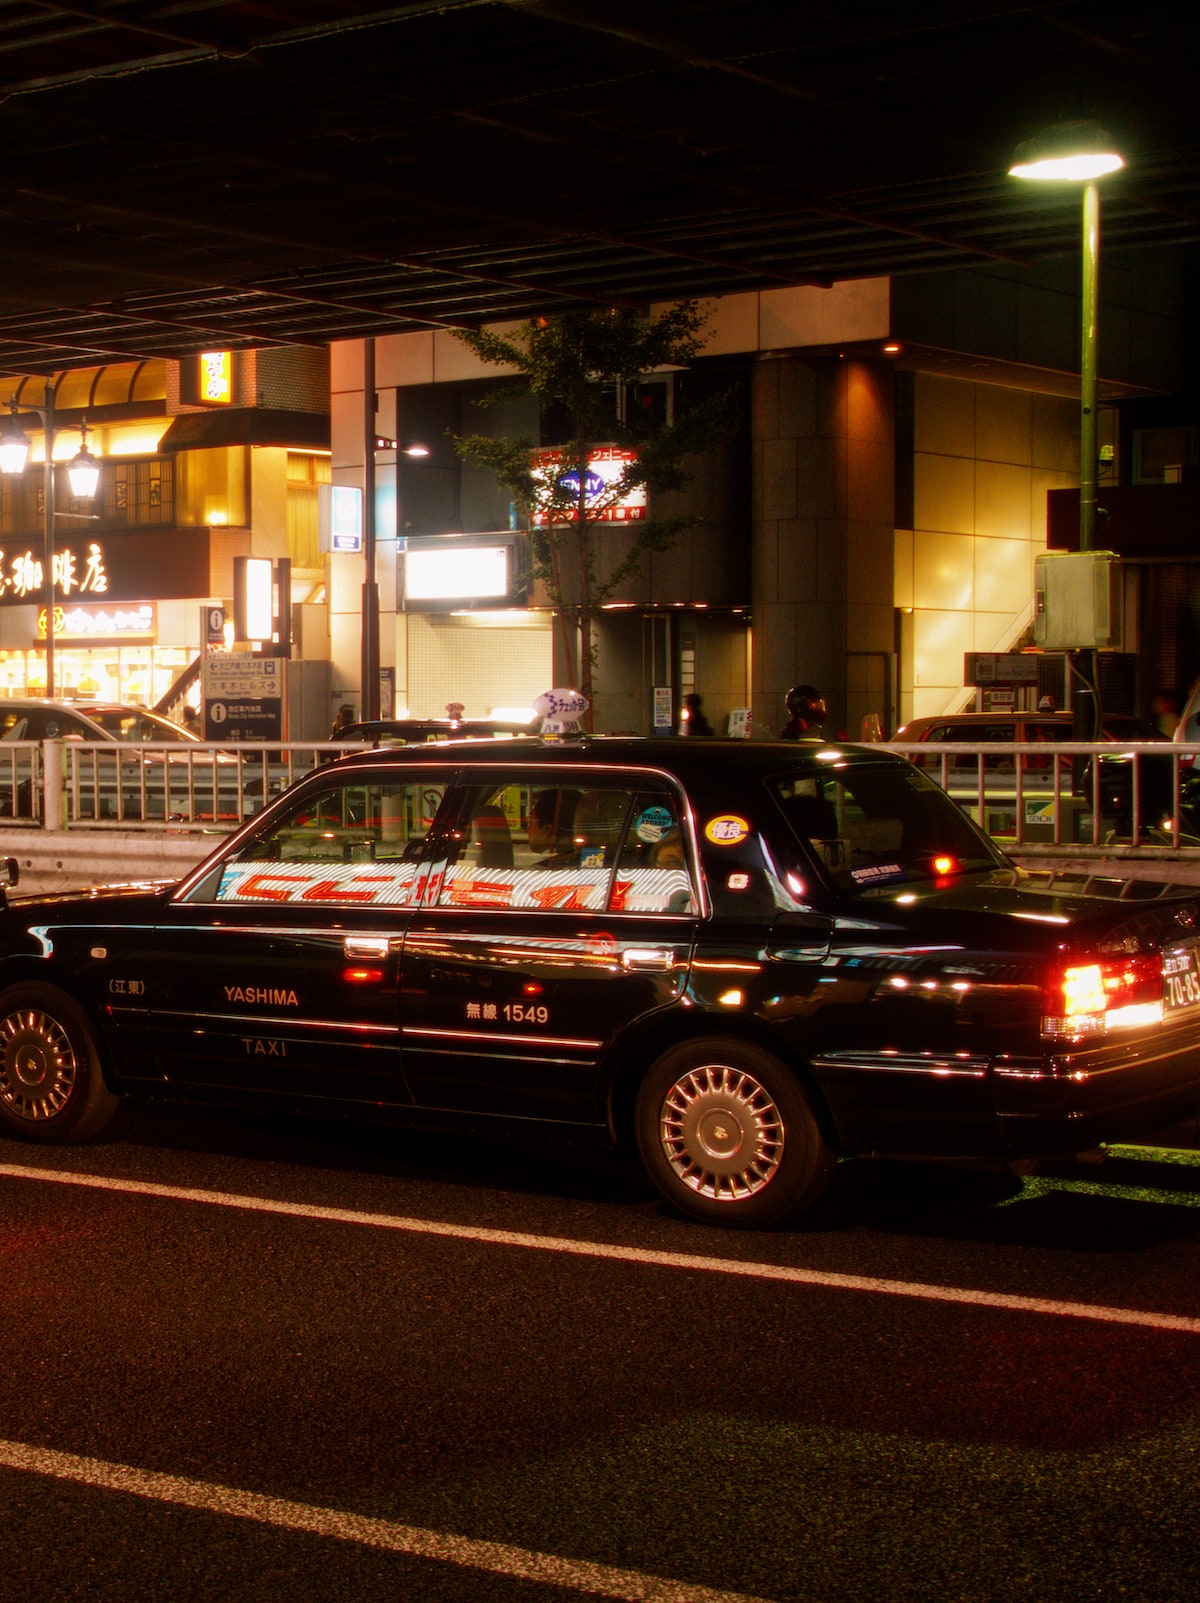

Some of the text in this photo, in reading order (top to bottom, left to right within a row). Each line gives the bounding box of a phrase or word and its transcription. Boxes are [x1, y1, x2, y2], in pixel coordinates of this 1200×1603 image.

[712, 822, 741, 839] 優良
[109, 979, 145, 995] (江東)
[224, 986, 299, 1006] YASHIMA
[466, 1002, 548, 1023] 無線 1549
[242, 1038, 287, 1056] TAXI
